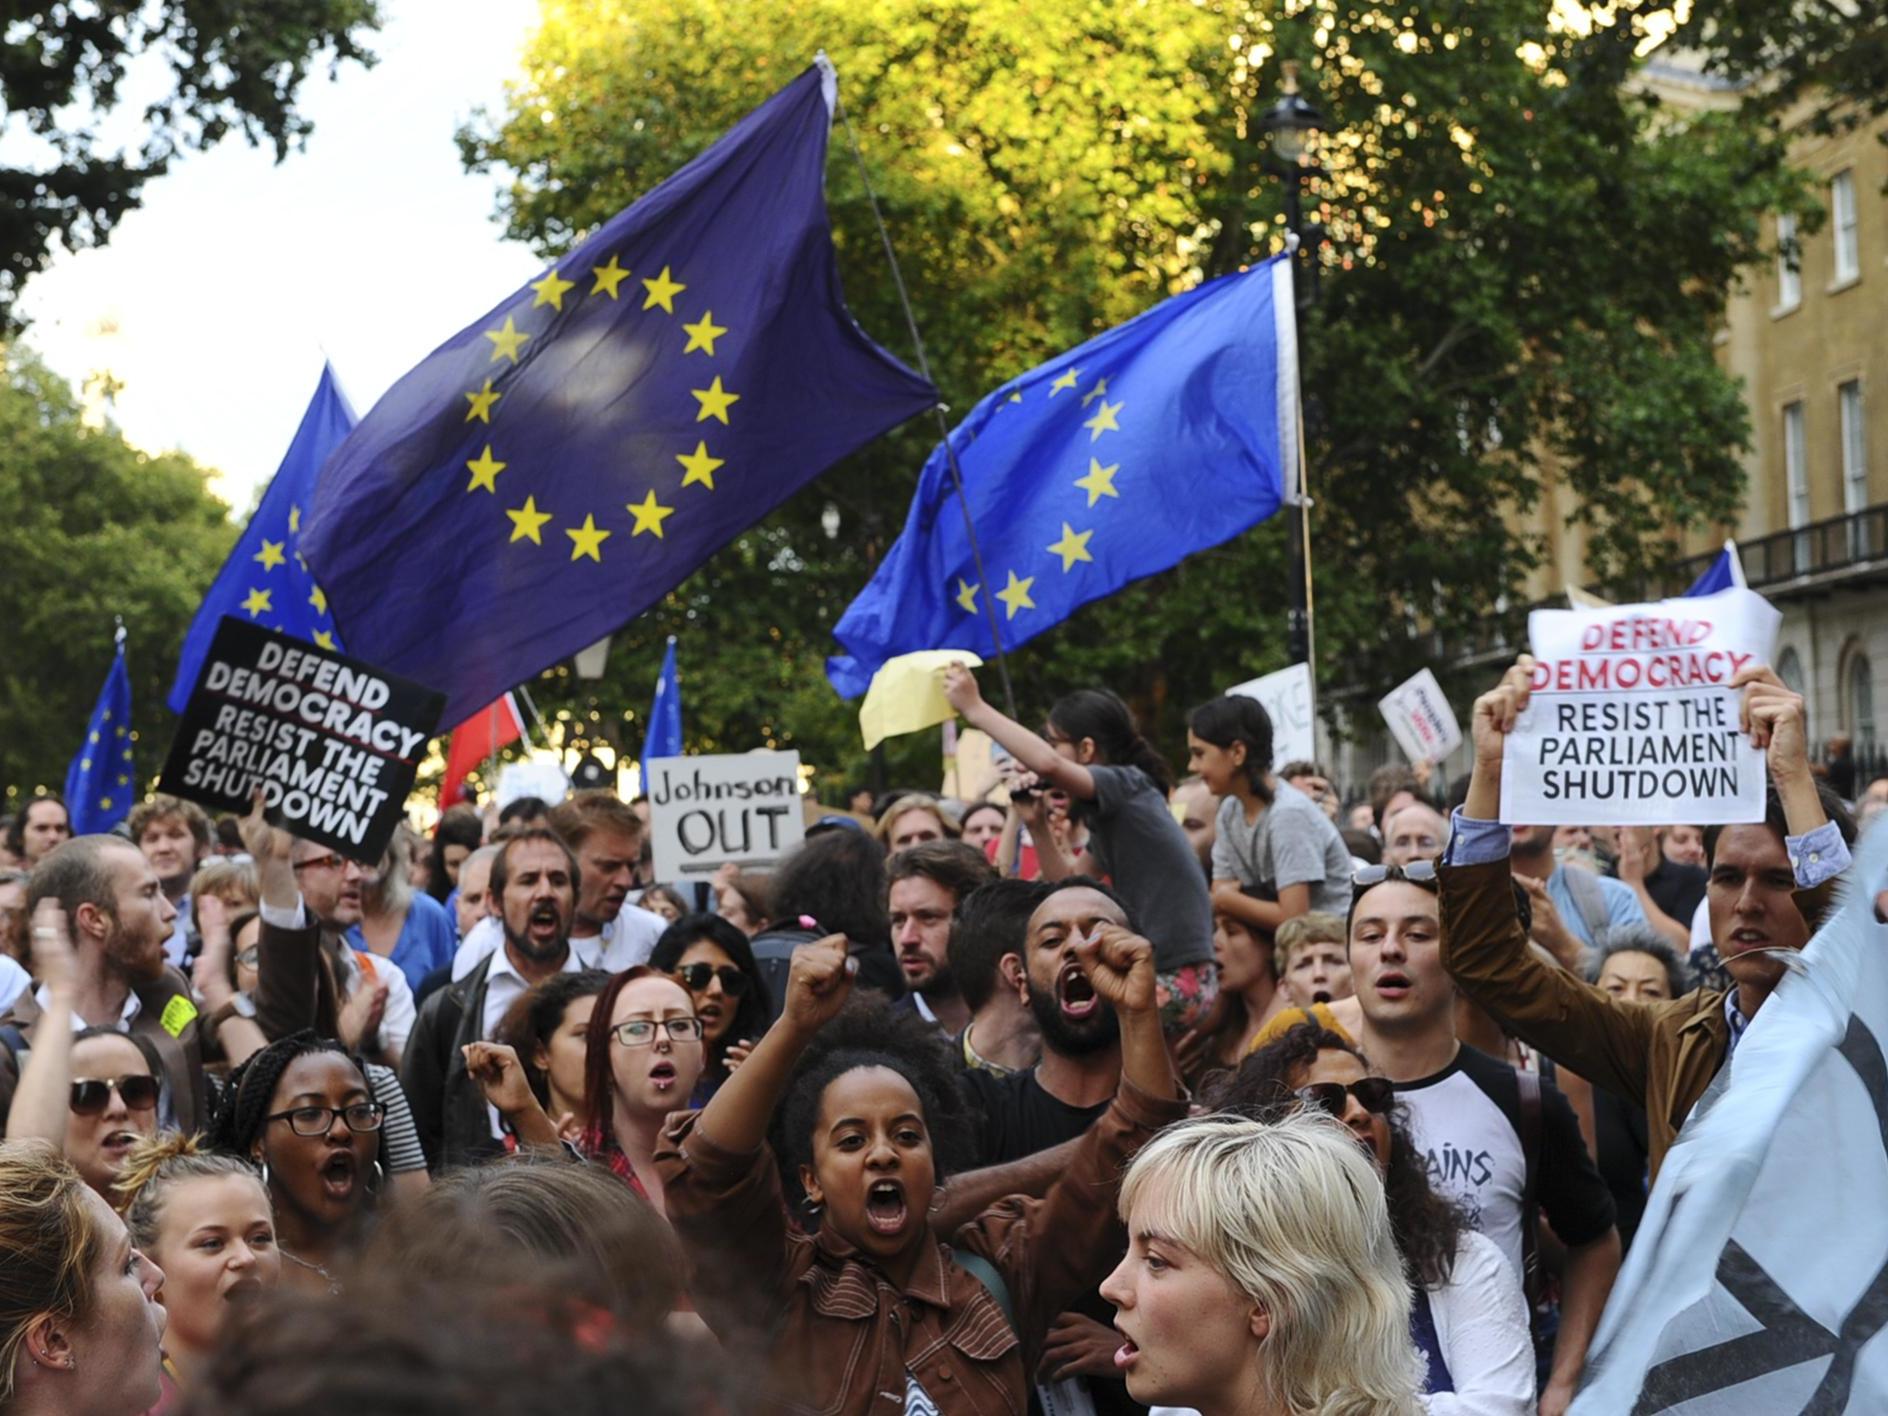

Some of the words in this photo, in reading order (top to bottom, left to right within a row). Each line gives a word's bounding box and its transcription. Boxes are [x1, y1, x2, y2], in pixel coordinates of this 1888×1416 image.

[1581, 618, 1713, 651] DEFEND
[257, 642, 389, 710] DEFEND
[1531, 651, 1754, 690] DEMOCRACY
[206, 661, 424, 759] DEMOCRACY
[1558, 701, 1669, 732] RESIST
[1678, 697, 1726, 729] THE
[215, 705, 317, 757] RESIST
[322, 739, 385, 785] THE
[1539, 731, 1739, 765] PARLIAMENT
[190, 729, 388, 817] PARLIAMENT
[655, 768, 795, 805] Johnson
[1543, 767, 1738, 799] SHUTDOWN
[183, 760, 370, 844] SHUTDOWN
[677, 805, 789, 855] OUT
